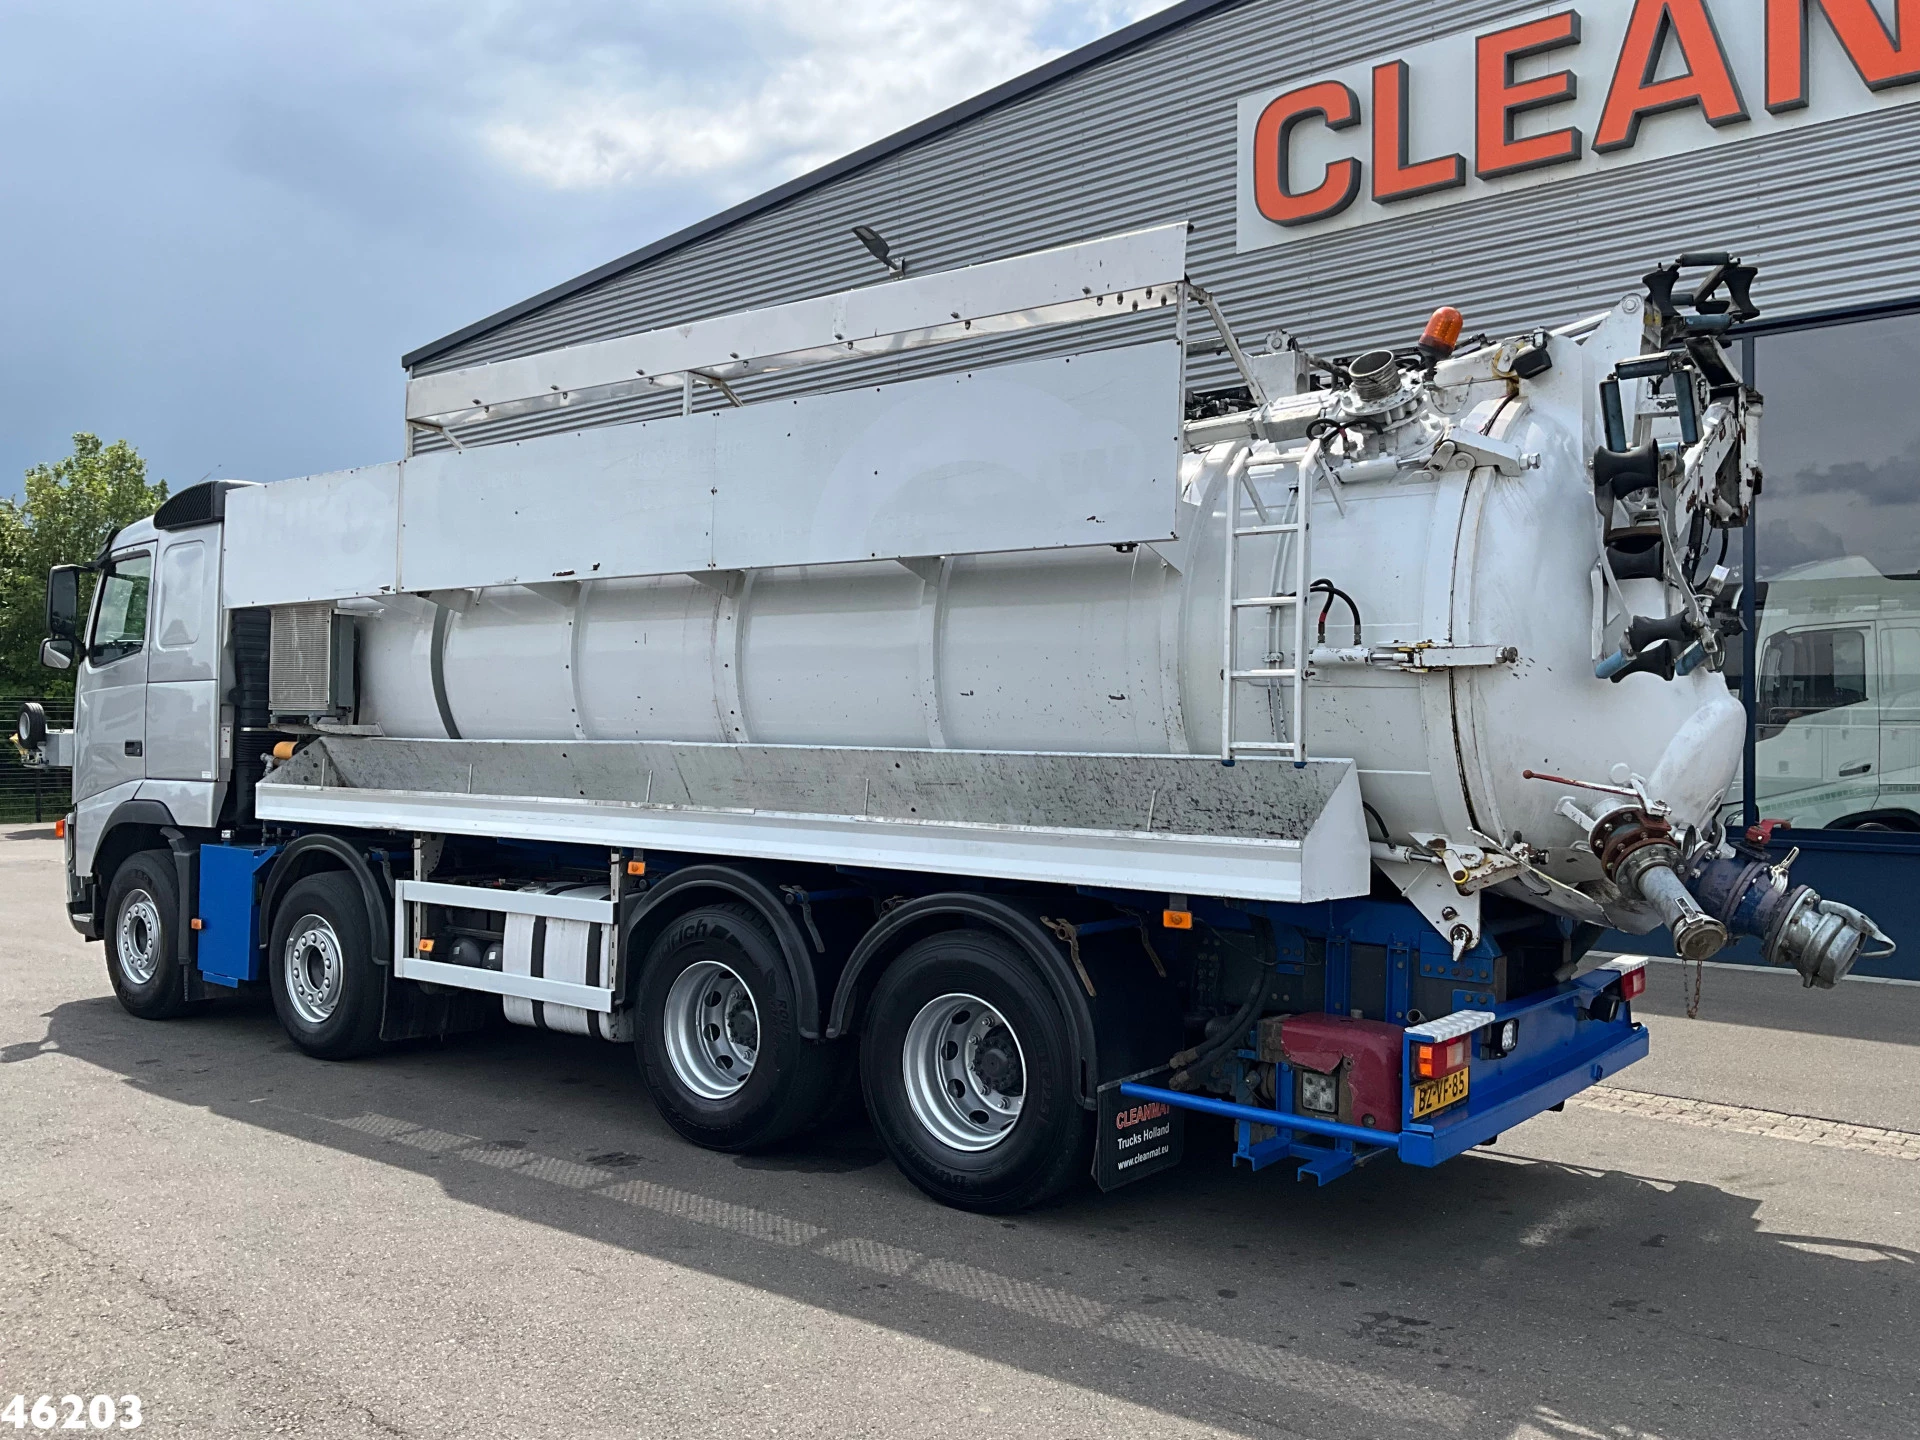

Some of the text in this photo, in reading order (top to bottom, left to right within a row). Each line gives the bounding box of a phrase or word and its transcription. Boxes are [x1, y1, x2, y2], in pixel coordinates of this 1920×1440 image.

[1418, 1071, 1465, 1112] BZ-VF-85
[1117, 1122, 1170, 1150] Trucks Holland
[1117, 1144, 1169, 1170] www.cleanmat.eu
